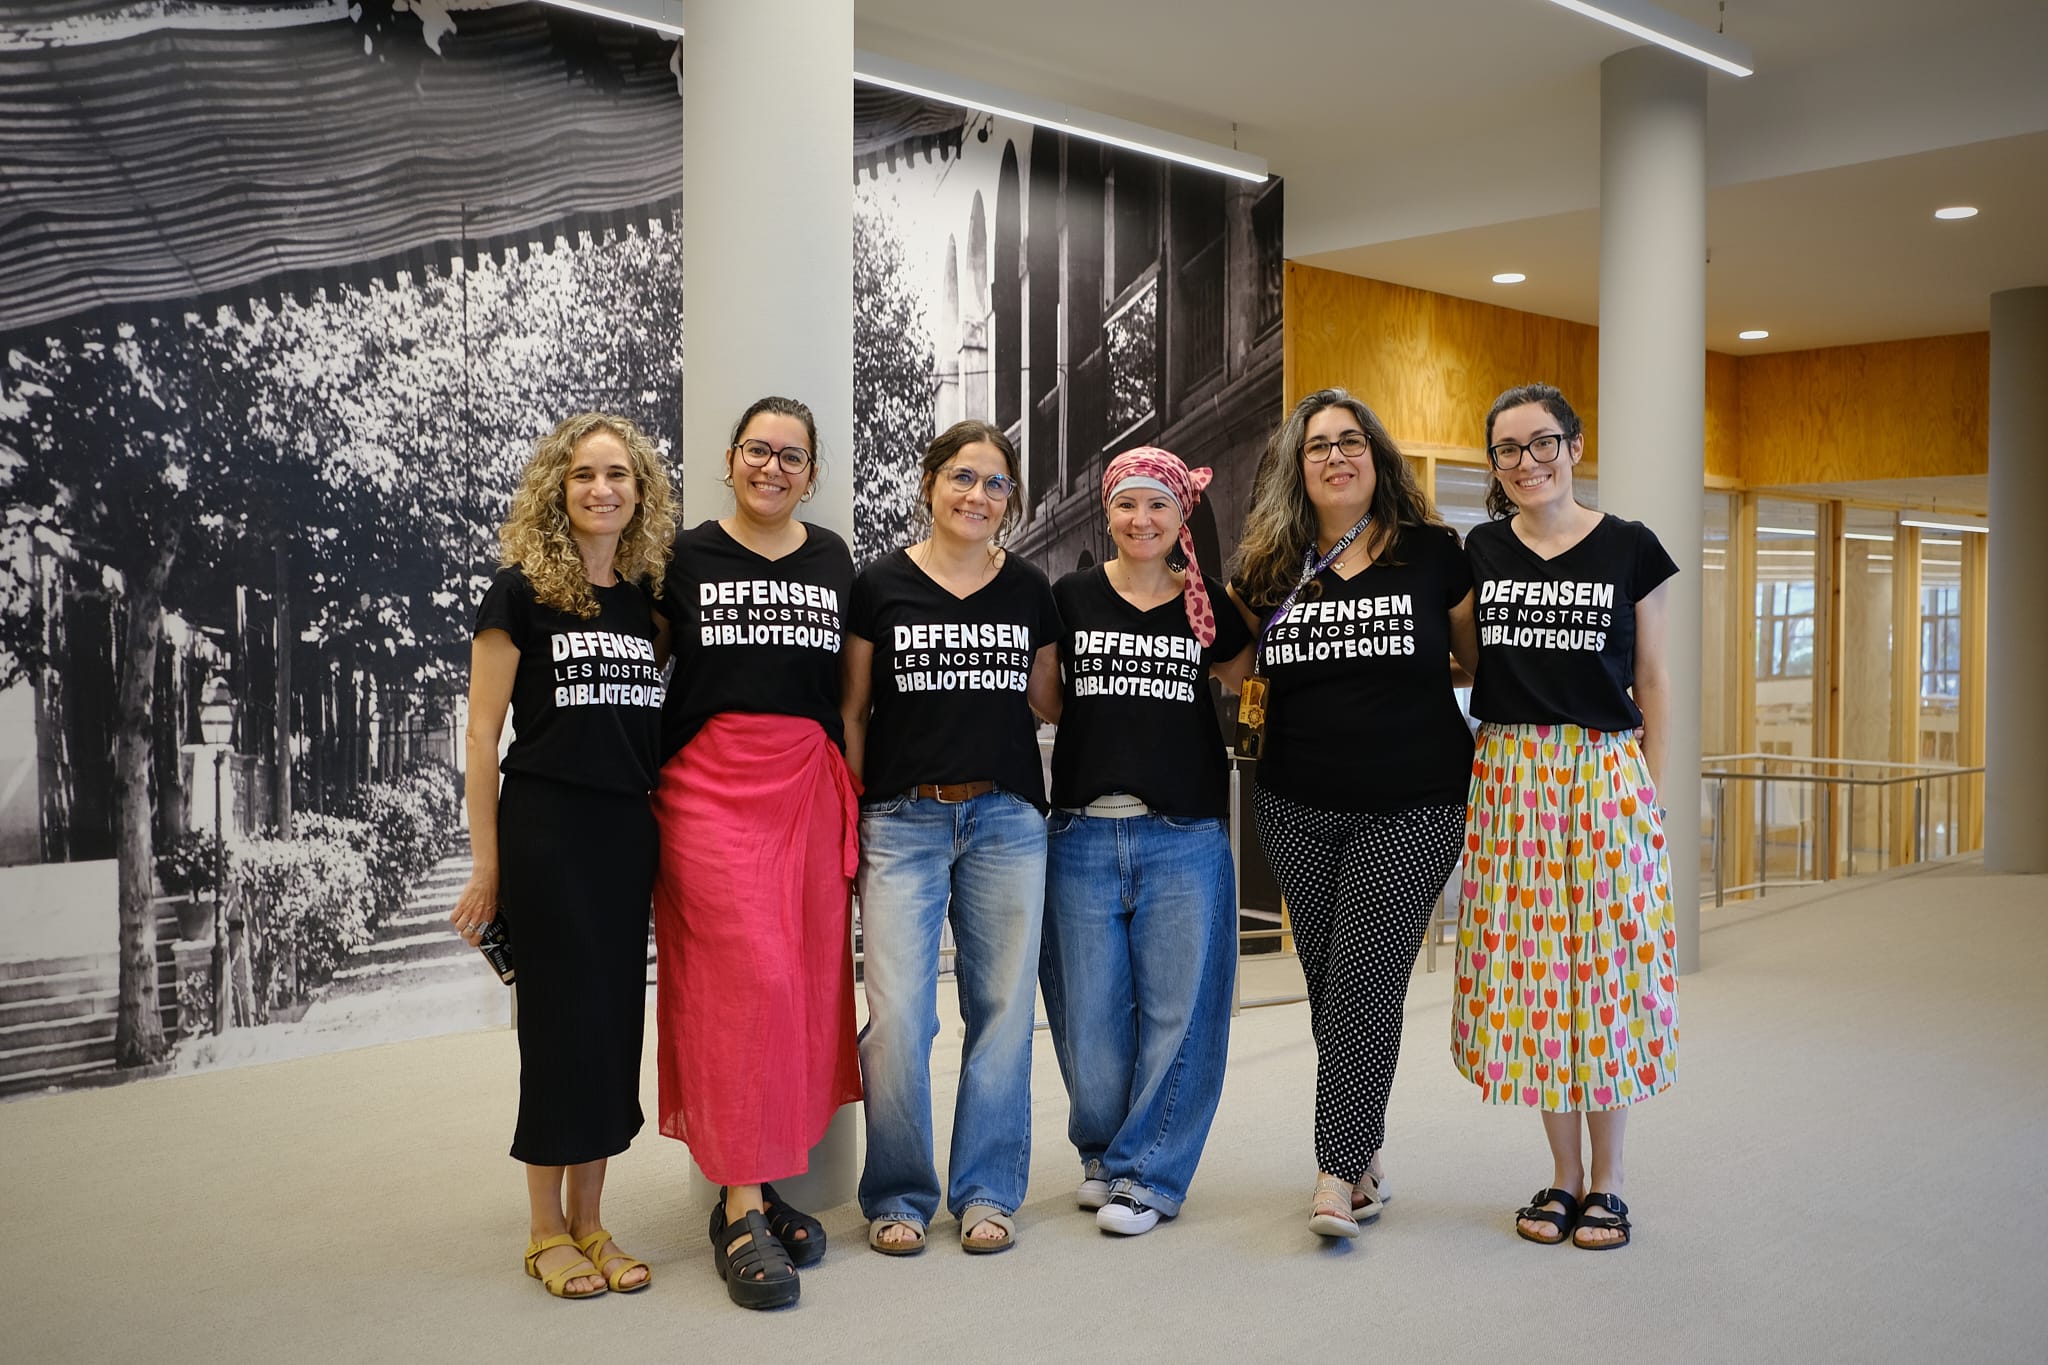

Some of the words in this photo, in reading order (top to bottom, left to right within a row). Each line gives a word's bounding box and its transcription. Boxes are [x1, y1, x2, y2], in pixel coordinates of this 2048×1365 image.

[699, 580, 839, 614] DEFENSEM
[1479, 579, 1615, 610] DEFENSEM
[700, 608, 739, 622] LES
[748, 608, 841, 630] NOSTRES
[1266, 626, 1300, 642] LES
[1310, 618, 1415, 639] NOSTRES
[1479, 607, 1509, 622] LES
[1517, 608, 1612, 628] NOSTRES
[700, 624, 841, 654] BIBLIOTEQUES
[893, 623, 1030, 652] DEFENSEM
[1074, 630, 1202, 666] DEFENSEM
[1265, 634, 1415, 666] BIBLIOTEQUES
[1480, 624, 1607, 652] BIBLIOTEQUES
[554, 663, 593, 682] LES
[894, 653, 930, 670] LES
[939, 652, 1029, 669] NOSTRES
[1074, 657, 1103, 673] LES
[1111, 658, 1198, 681] NOSTRES
[894, 669, 1028, 693] BIBLIOTEQUES
[1075, 675, 1195, 703] BIBLIOTEQUES
